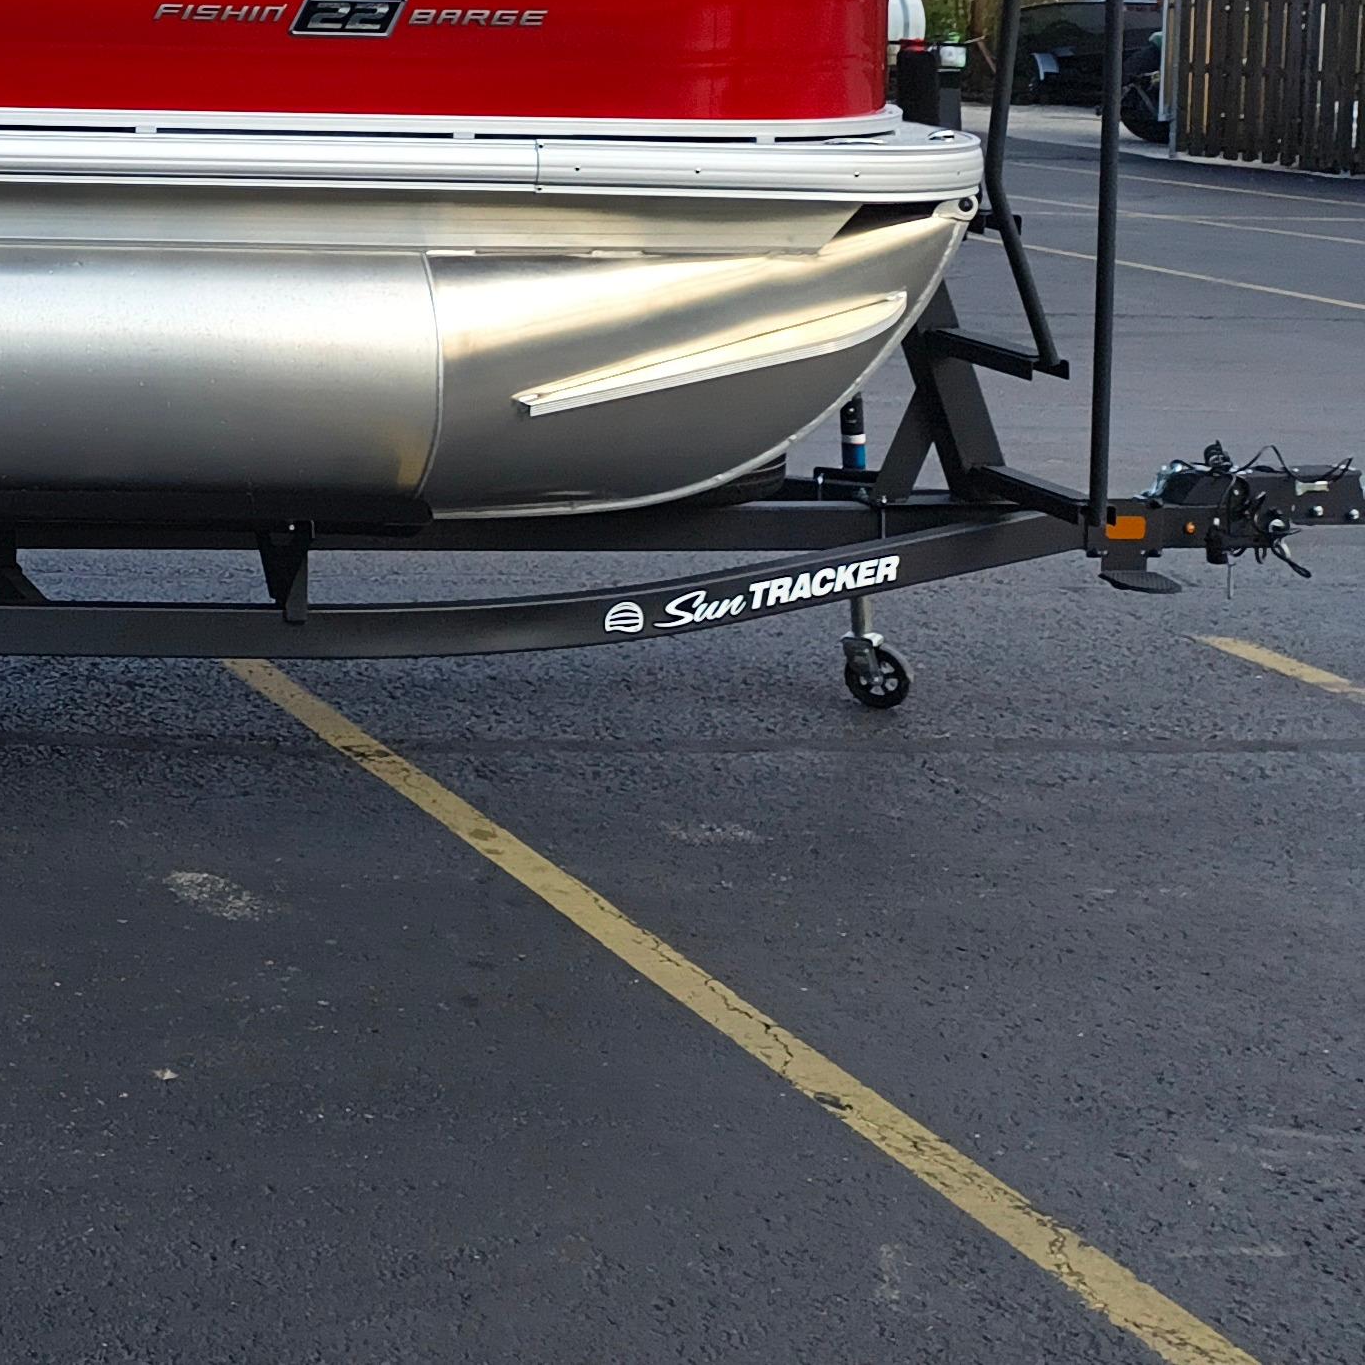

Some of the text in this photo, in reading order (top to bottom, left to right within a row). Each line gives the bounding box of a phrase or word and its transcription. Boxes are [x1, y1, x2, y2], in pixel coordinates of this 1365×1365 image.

[306, 1, 391, 30] 22
[408, 9, 549, 27] BARGE
[653, 555, 900, 628] Sun TRACKER
